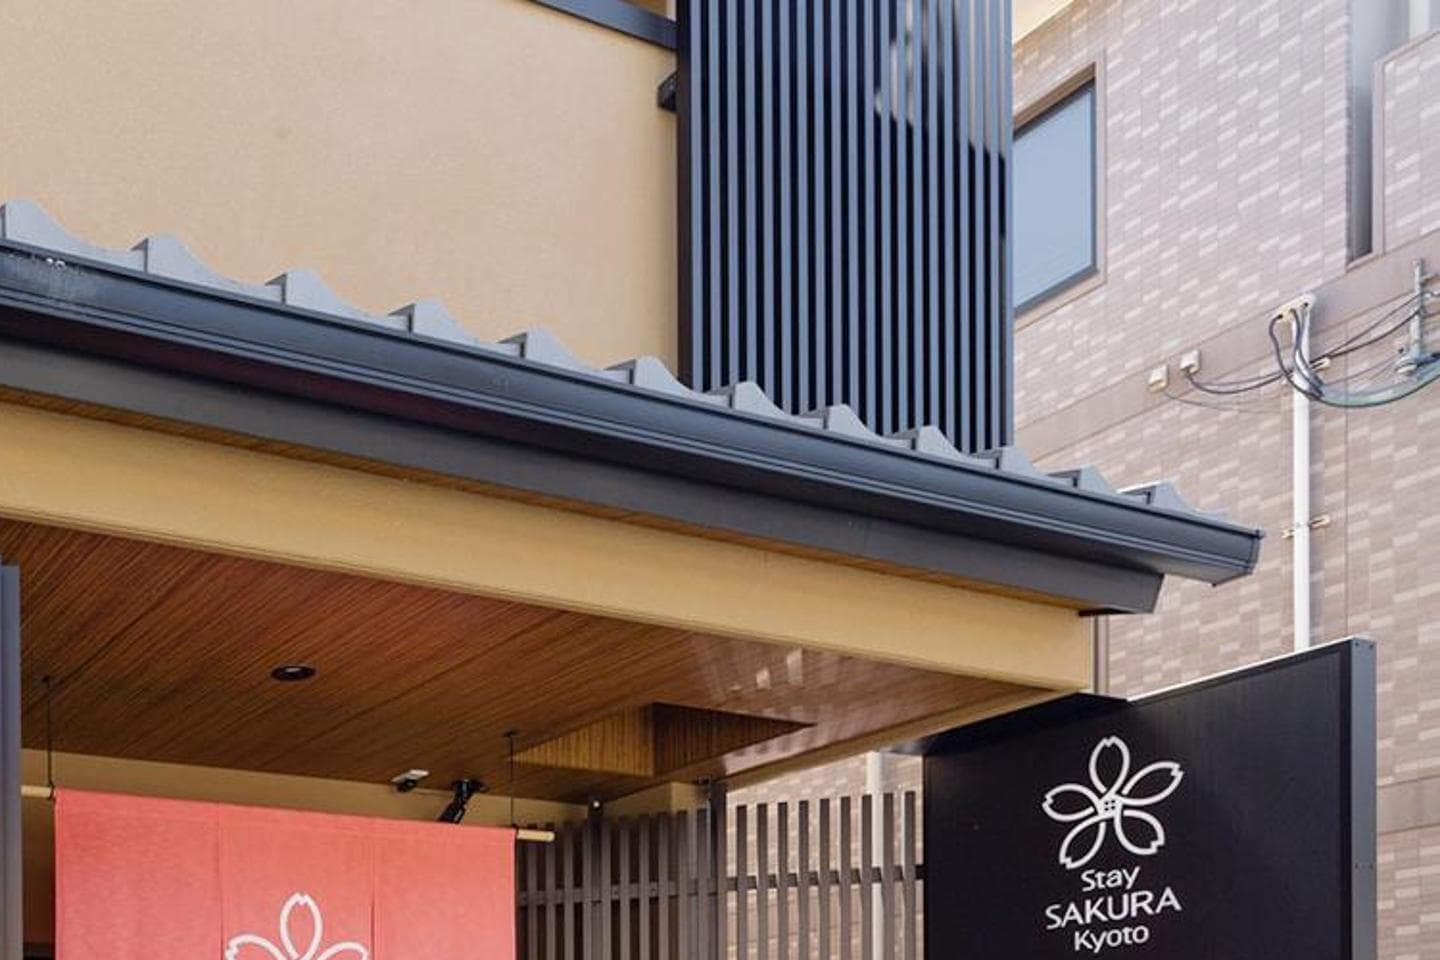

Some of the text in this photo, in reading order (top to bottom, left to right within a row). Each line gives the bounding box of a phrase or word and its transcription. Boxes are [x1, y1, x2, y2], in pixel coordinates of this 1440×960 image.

[1081, 865, 1141, 892] Stay
[1045, 886, 1182, 931] SAKURA
[1074, 925, 1150, 954] Kyoto
